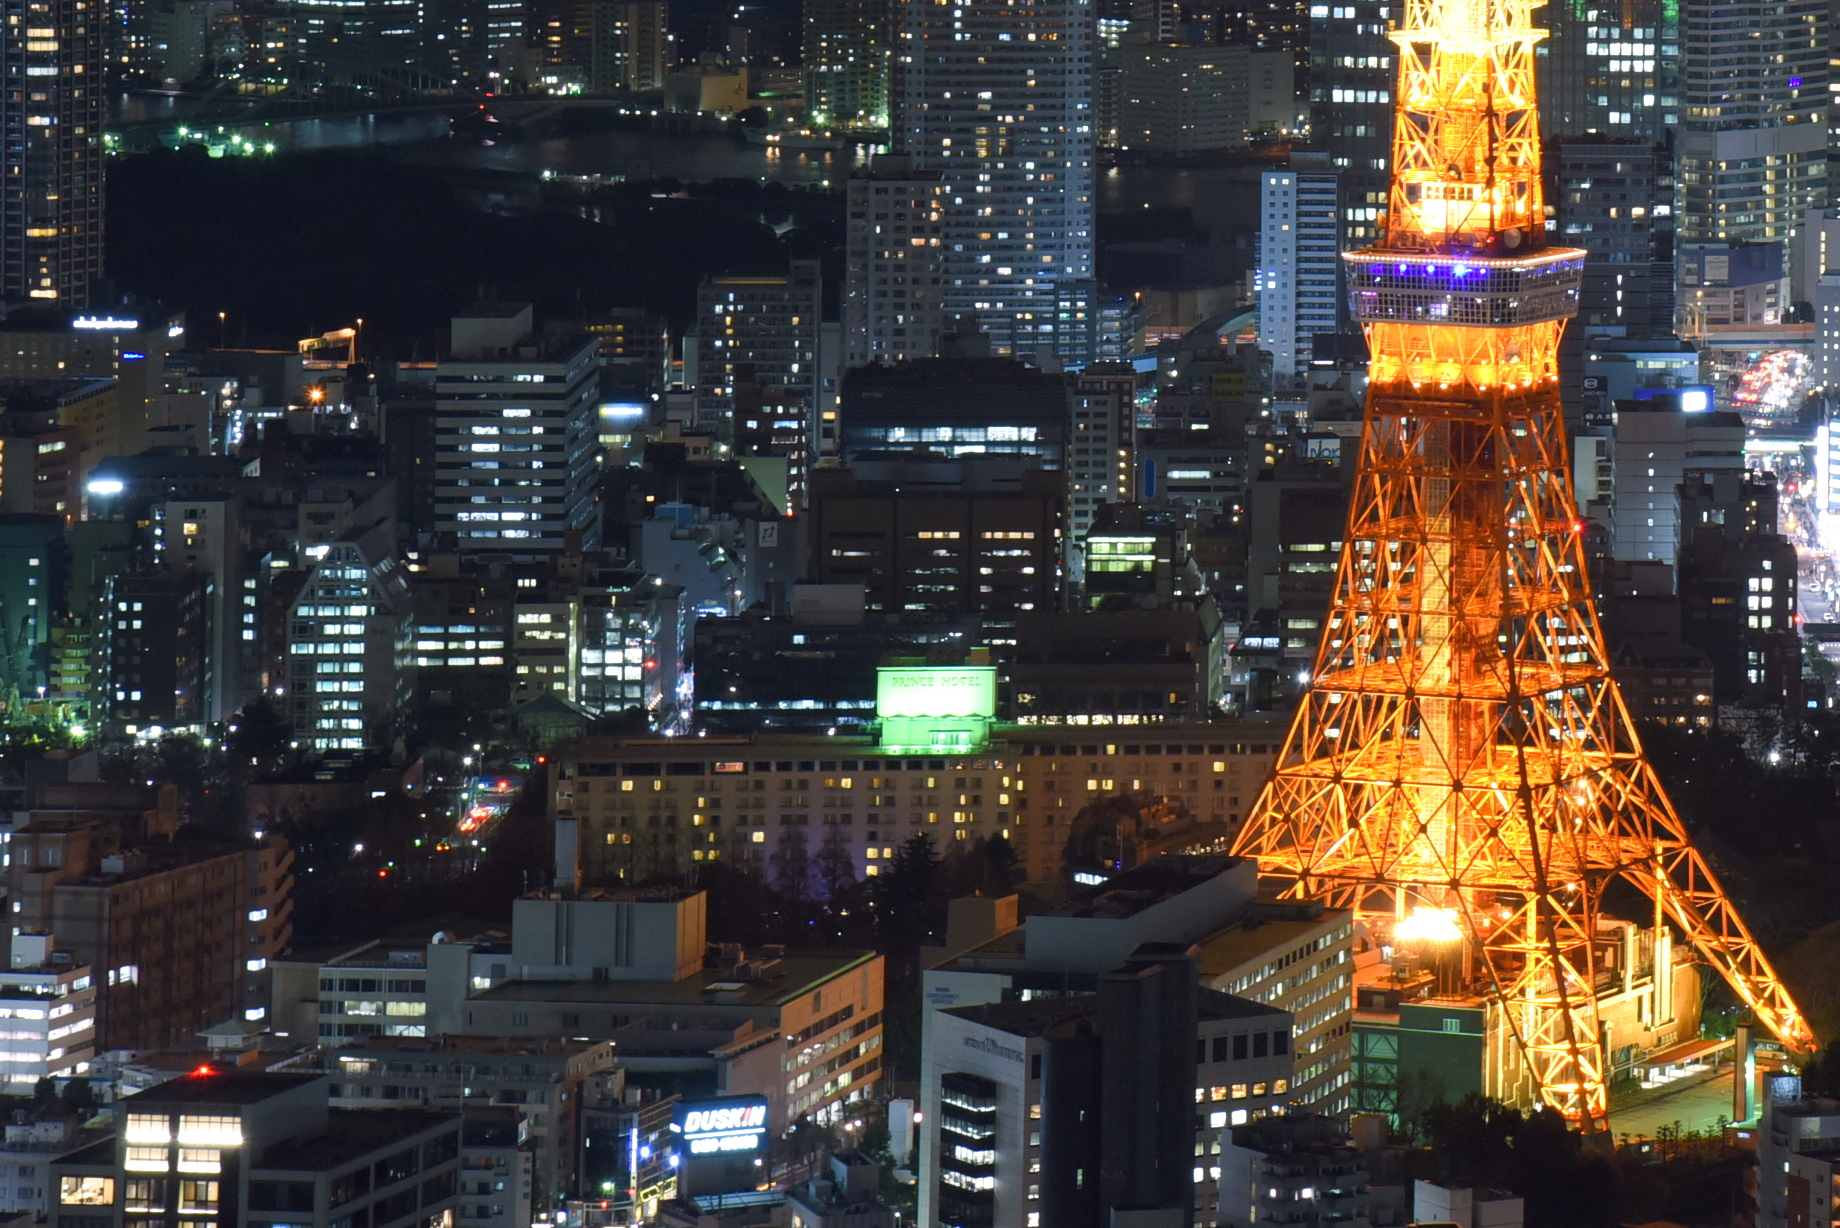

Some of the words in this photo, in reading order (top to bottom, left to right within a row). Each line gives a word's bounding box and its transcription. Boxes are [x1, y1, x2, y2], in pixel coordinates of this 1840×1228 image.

[892, 677, 934, 687] PRINCE
[941, 676, 981, 686] HOTEL
[684, 1105, 766, 1132] DUSKIN
